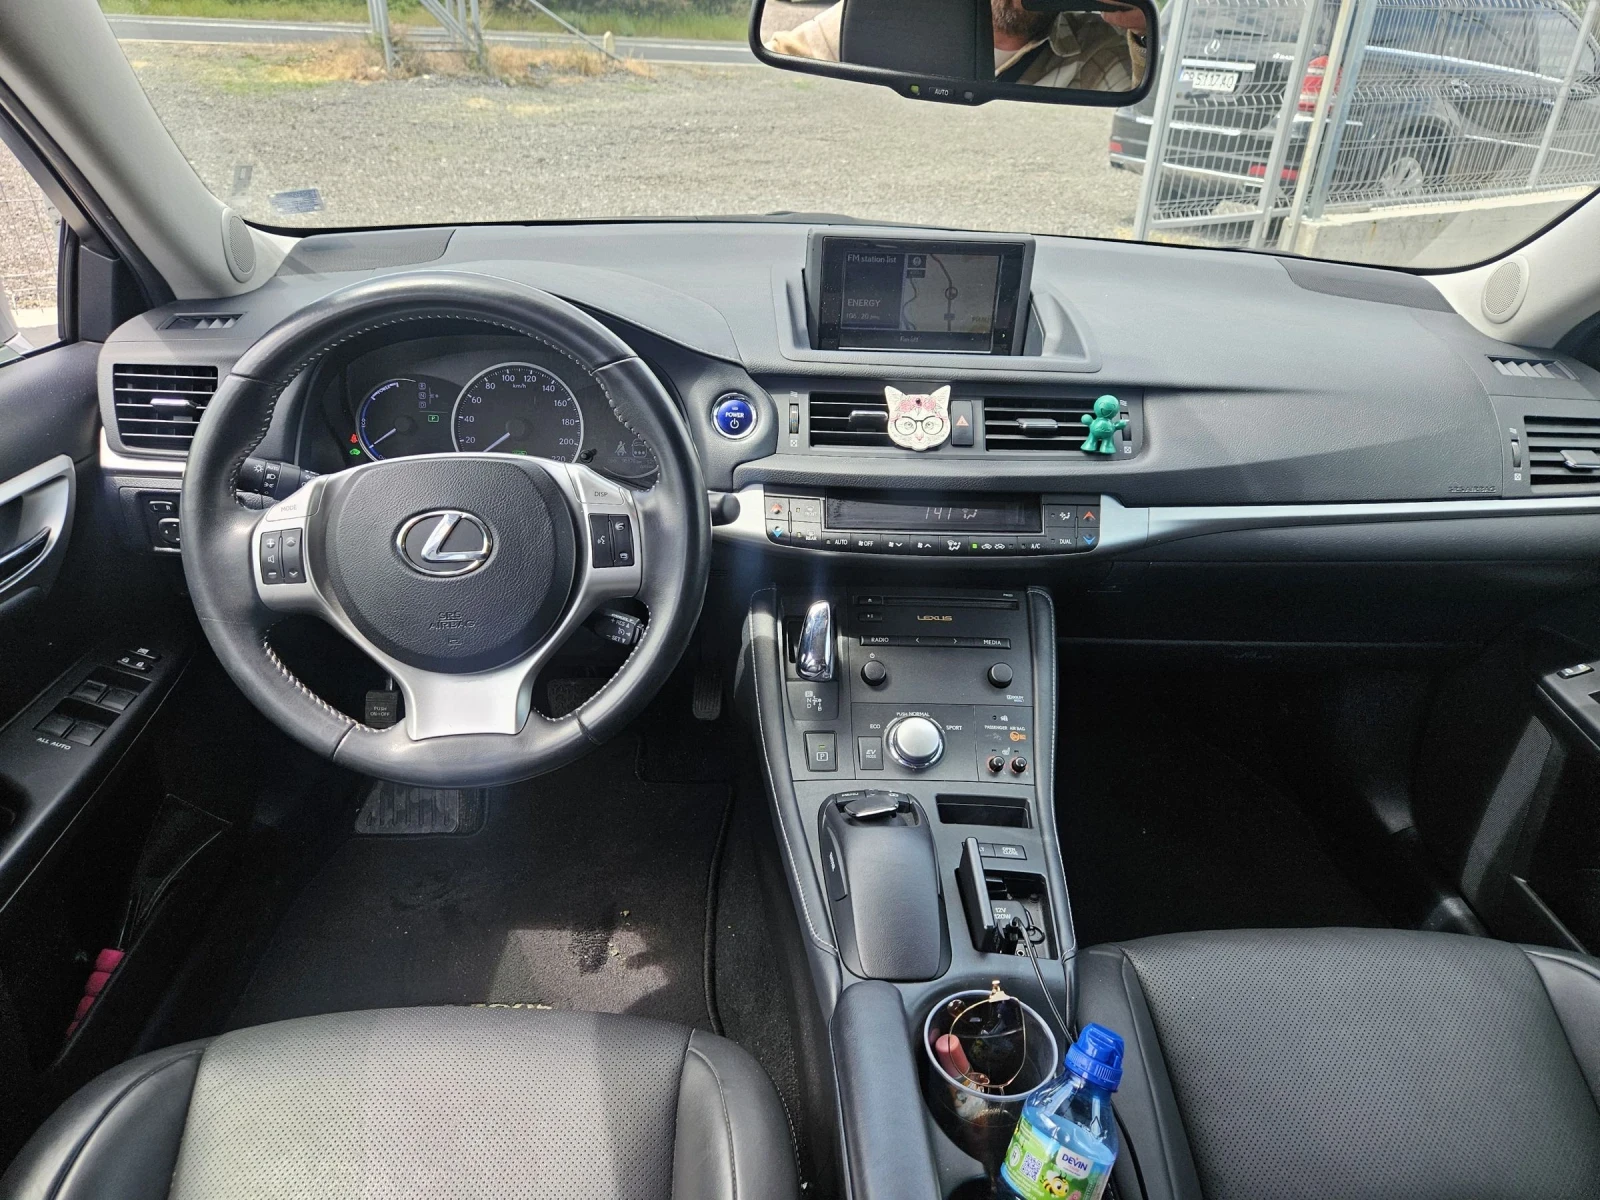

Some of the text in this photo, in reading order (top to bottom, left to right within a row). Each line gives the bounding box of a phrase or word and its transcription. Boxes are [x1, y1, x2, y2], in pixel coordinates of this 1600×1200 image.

[847, 254, 860, 262] FM
[847, 298, 881, 307] ENERGY
[439, 612, 462, 620] SRS
[429, 620, 476, 630] AIRBAG
[50, 741, 72, 750] AUTO
[1061, 1153, 1088, 1171] DEVIN
